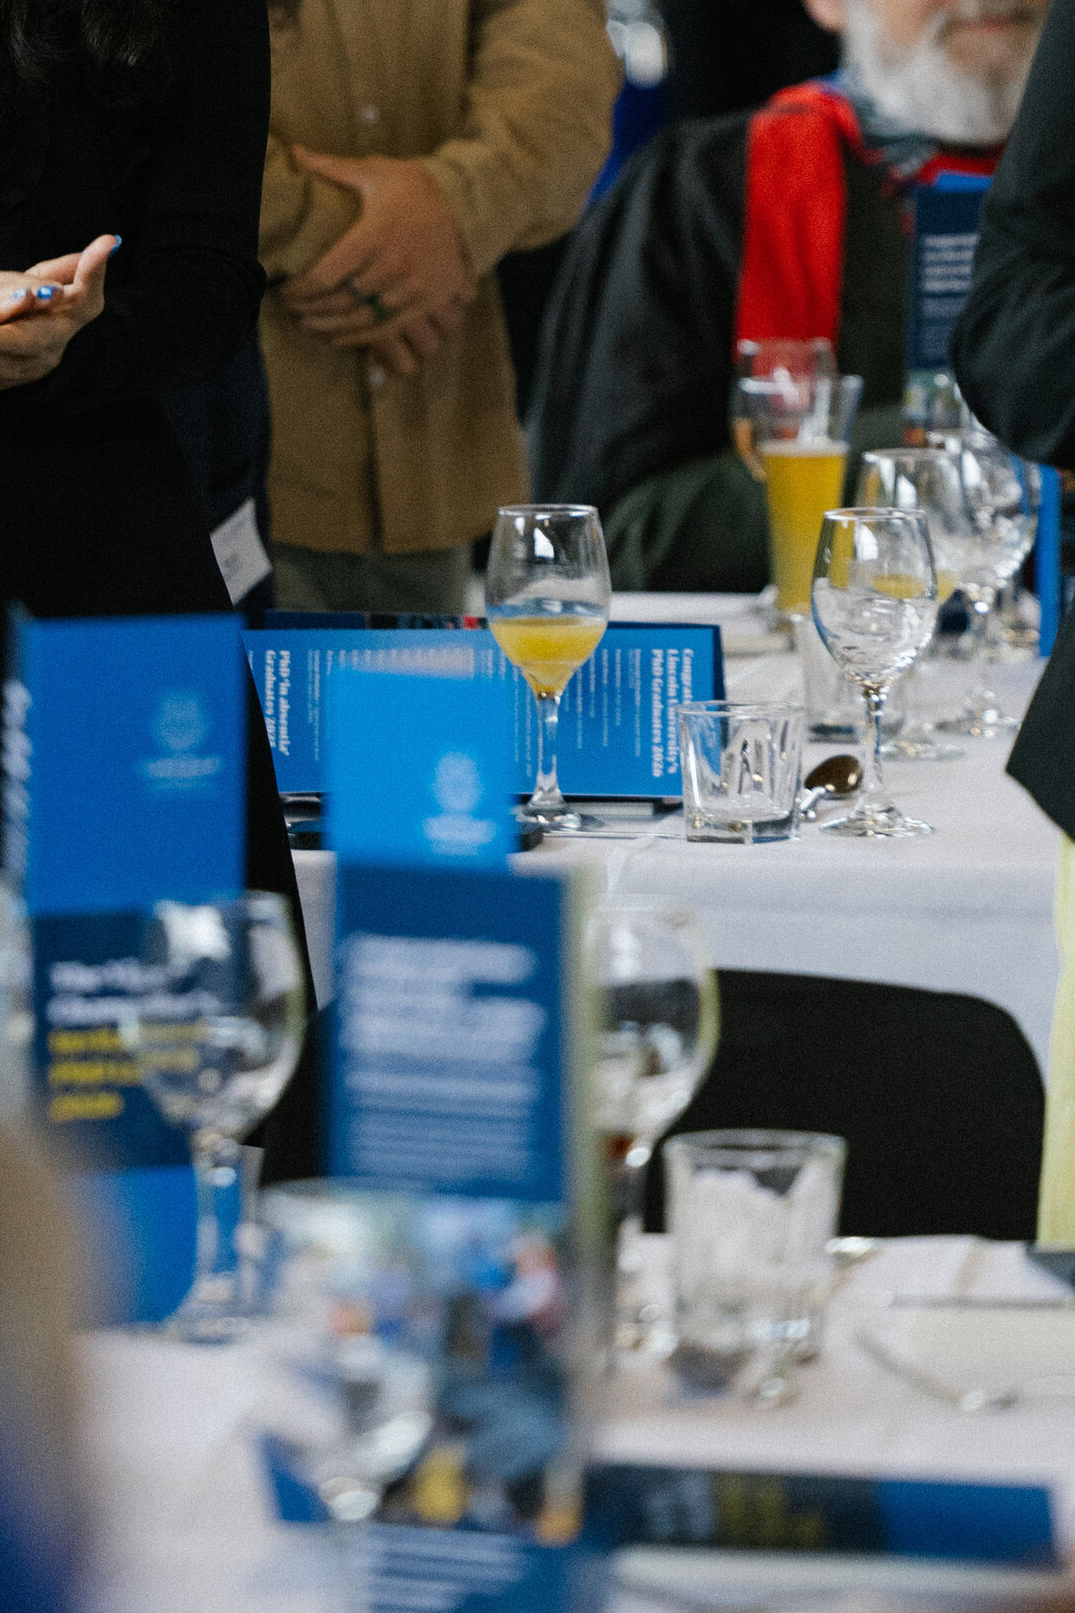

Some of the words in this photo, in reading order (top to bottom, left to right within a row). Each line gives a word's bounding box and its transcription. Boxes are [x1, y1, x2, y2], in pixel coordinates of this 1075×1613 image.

[266, 650, 276, 715] Graduates
[279, 650, 290, 677] PhD
[652, 649, 664, 676] PhD
[667, 649, 680, 697] Lincoln
[652, 678, 664, 744] Graduates
